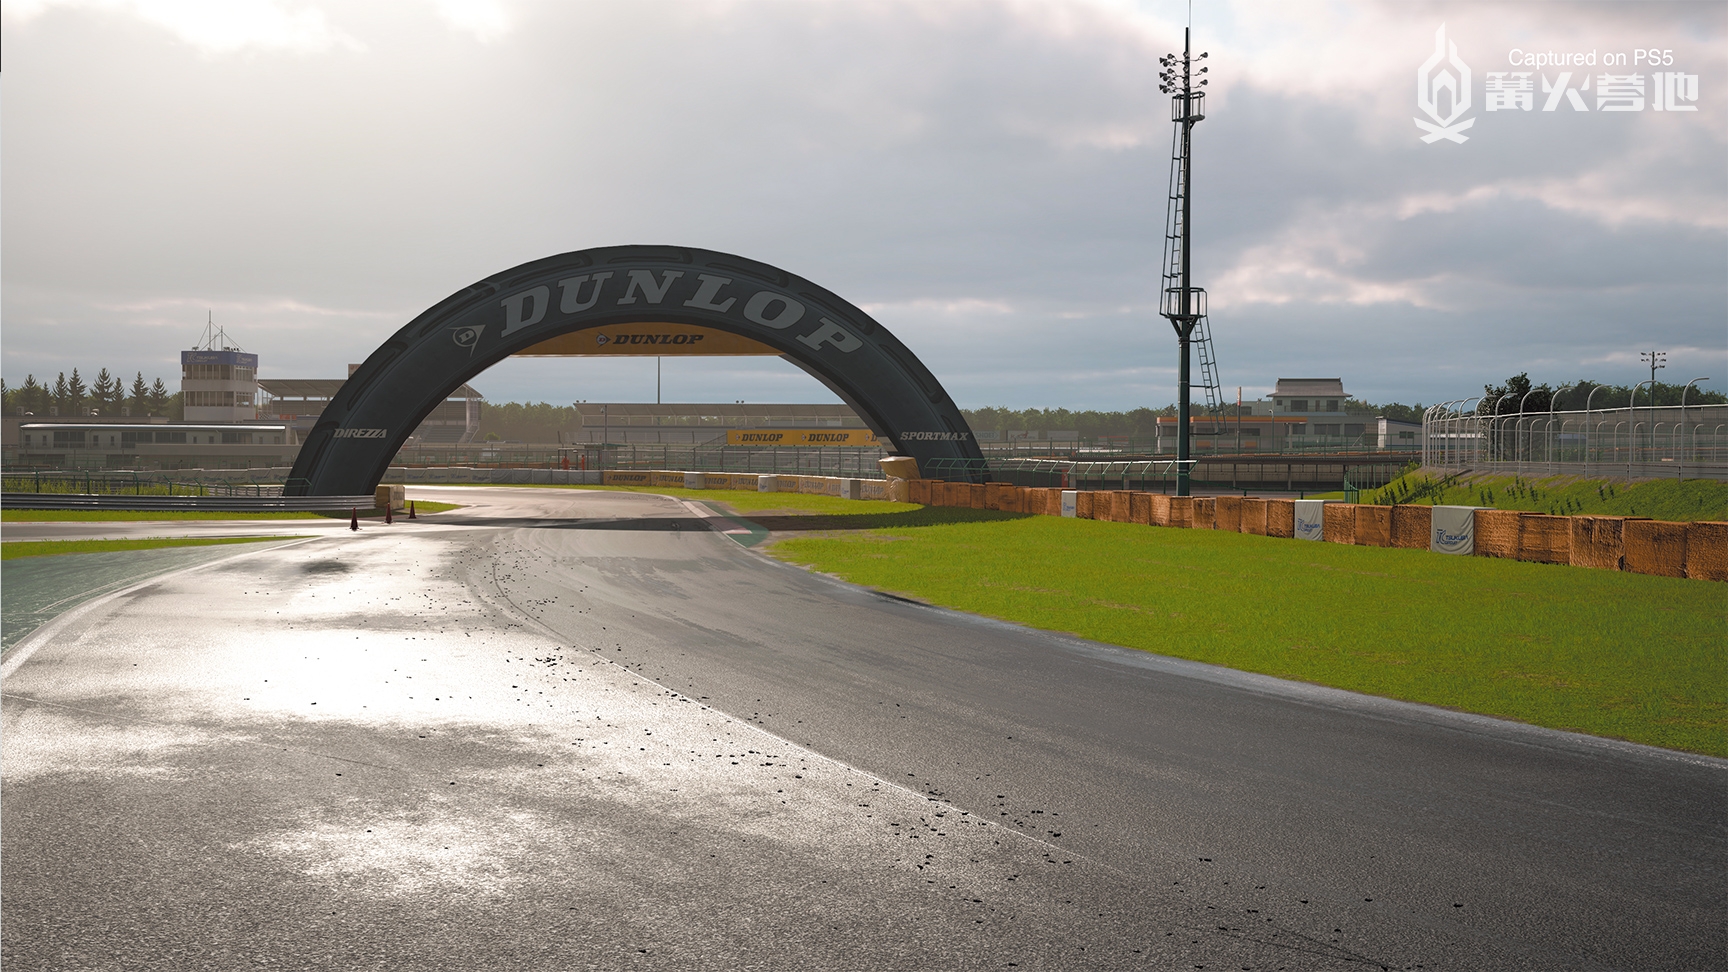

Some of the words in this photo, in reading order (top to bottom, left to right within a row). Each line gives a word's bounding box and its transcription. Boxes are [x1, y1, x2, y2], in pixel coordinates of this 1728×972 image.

[500, 269, 864, 354] DUNLOP
[613, 334, 704, 345] DUNLOP
[332, 428, 388, 439] DIREZZA
[741, 433, 784, 442] DUNLOP
[807, 433, 850, 442] DUNLOP
[899, 431, 969, 441] SPORTMAX
[612, 474, 647, 482] DUNLOP
[659, 474, 685, 483] DUNLO
